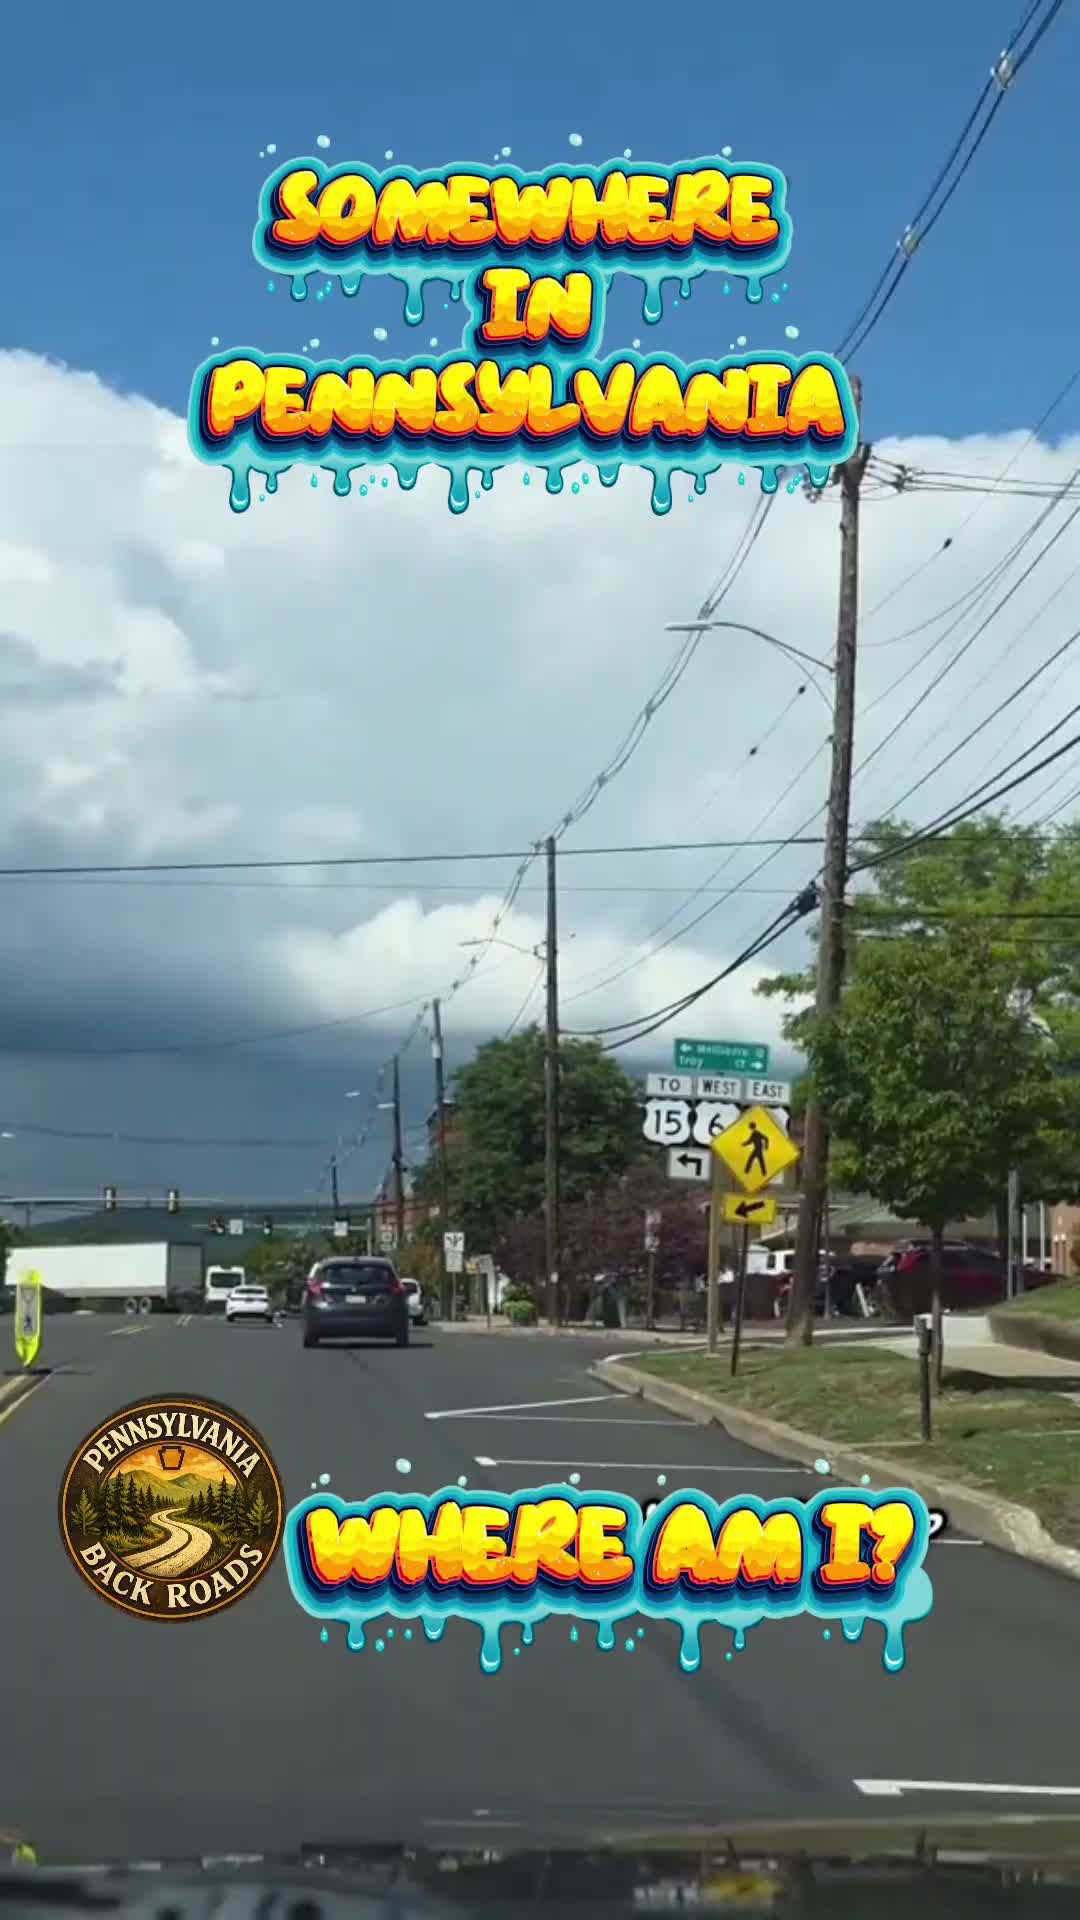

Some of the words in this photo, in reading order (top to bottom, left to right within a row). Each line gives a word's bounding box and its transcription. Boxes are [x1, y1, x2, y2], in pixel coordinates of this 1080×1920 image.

[658, 1077, 681, 1092] TO
[702, 1079, 736, 1096] WEST
[752, 1083, 785, 1099] EAST
[654, 1109, 681, 1136] 15
[708, 1113, 724, 1137] 6
